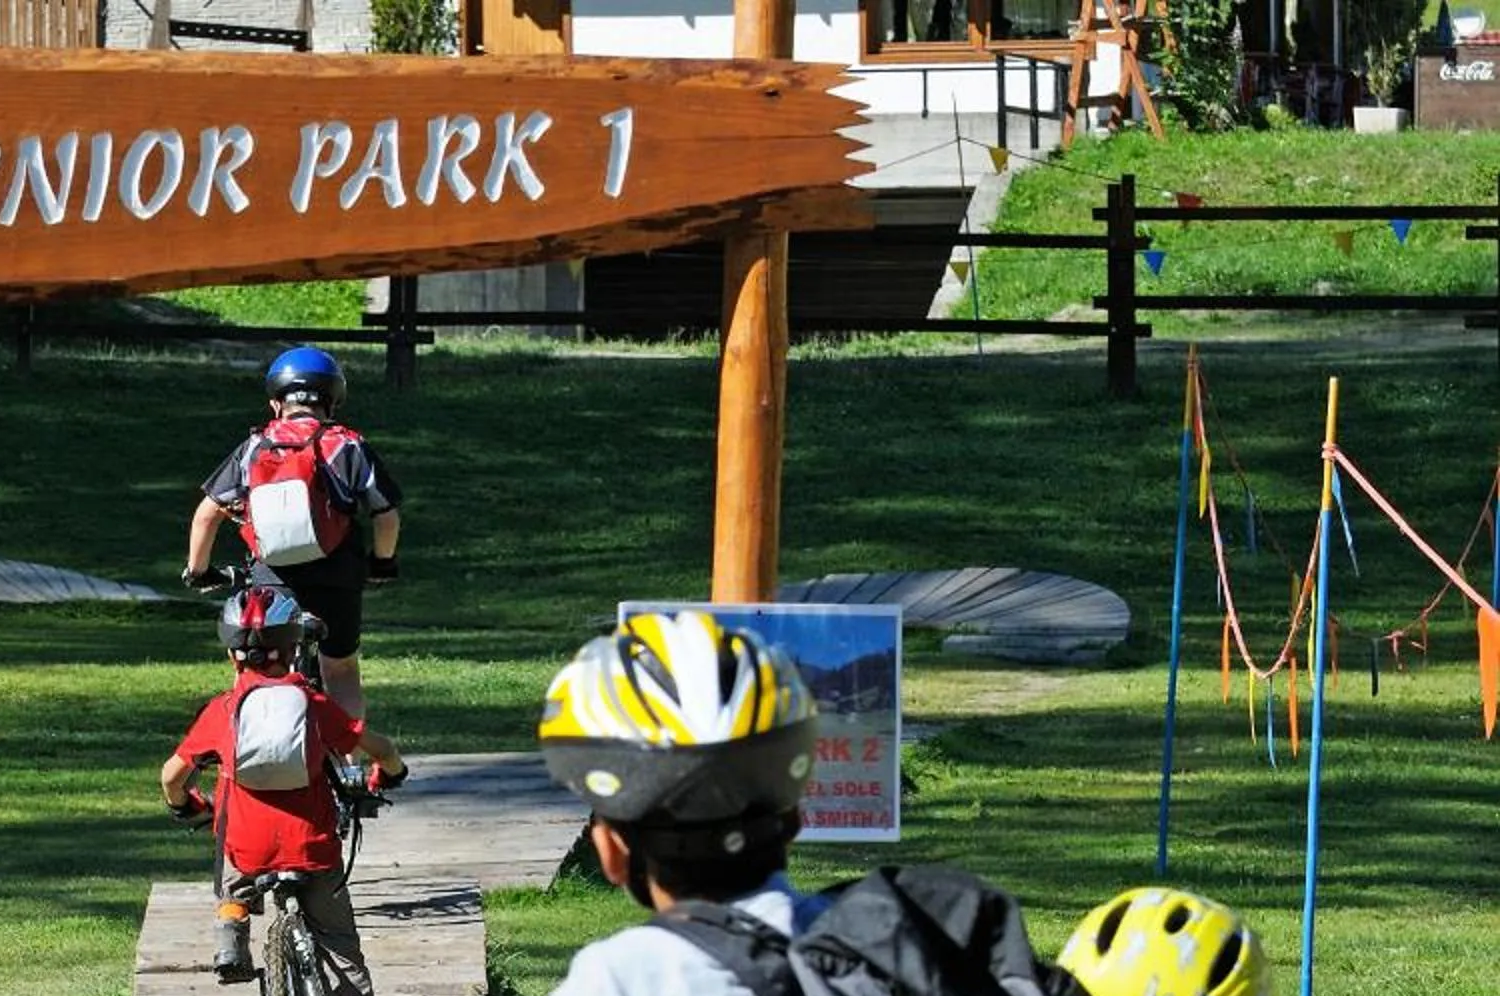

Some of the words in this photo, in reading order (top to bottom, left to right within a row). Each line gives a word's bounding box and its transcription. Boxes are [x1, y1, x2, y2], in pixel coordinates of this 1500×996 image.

[290, 110, 553, 213] PARK
[600, 107, 634, 198] 1
[813, 737, 852, 763] RK
[862, 737, 883, 763] 2
[805, 780, 827, 797] EL
[833, 781, 881, 797] SOLE
